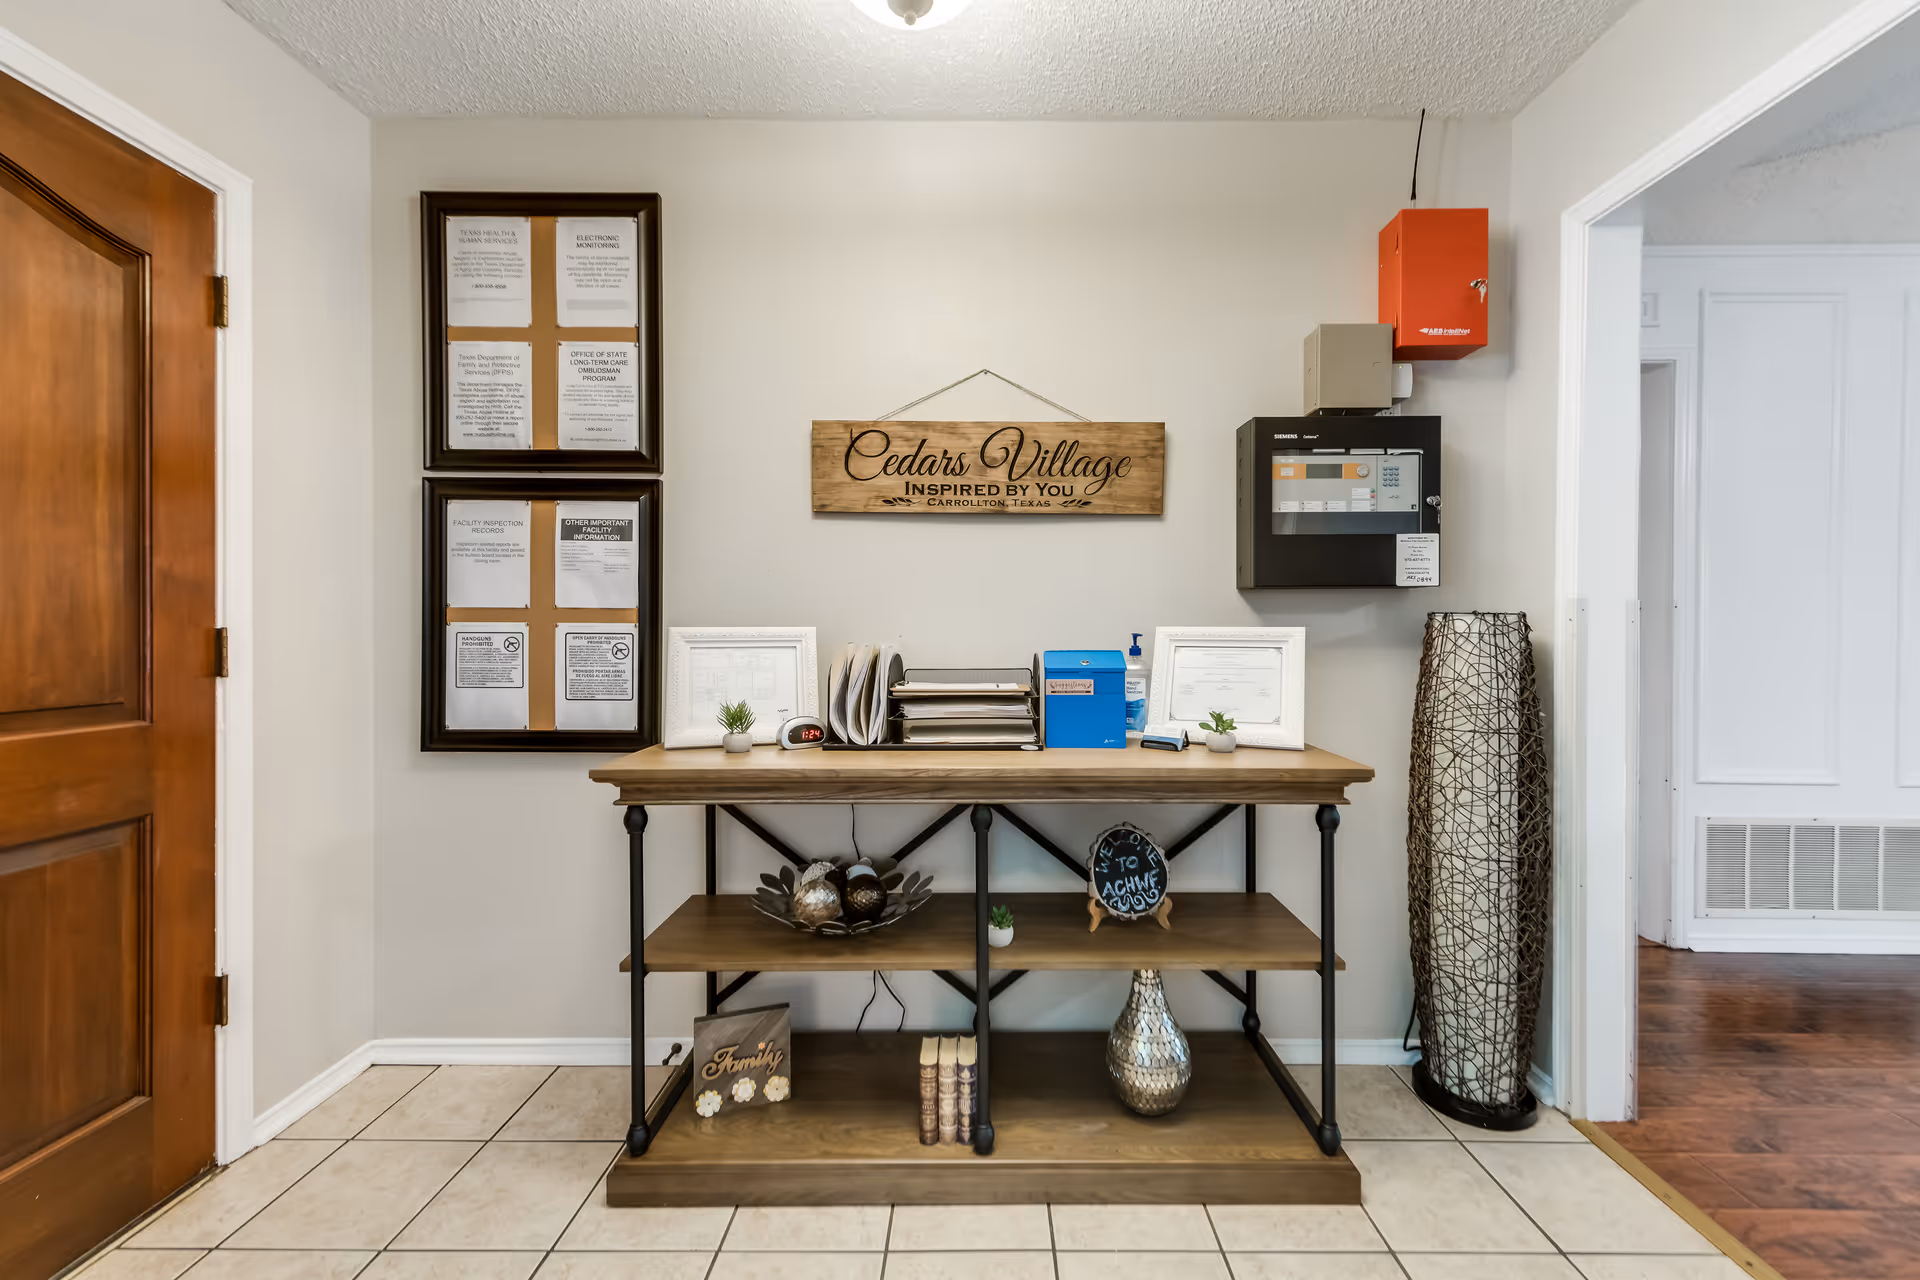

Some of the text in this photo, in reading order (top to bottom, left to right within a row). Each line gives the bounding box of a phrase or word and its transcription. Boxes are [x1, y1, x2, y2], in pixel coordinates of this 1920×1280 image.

[844, 426, 1132, 496] Cedars Village
[802, 730, 820, 739] 1:24
[1096, 833, 1162, 873] WELOME
[1116, 856, 1139, 872] TO
[702, 1040, 784, 1080] Family
